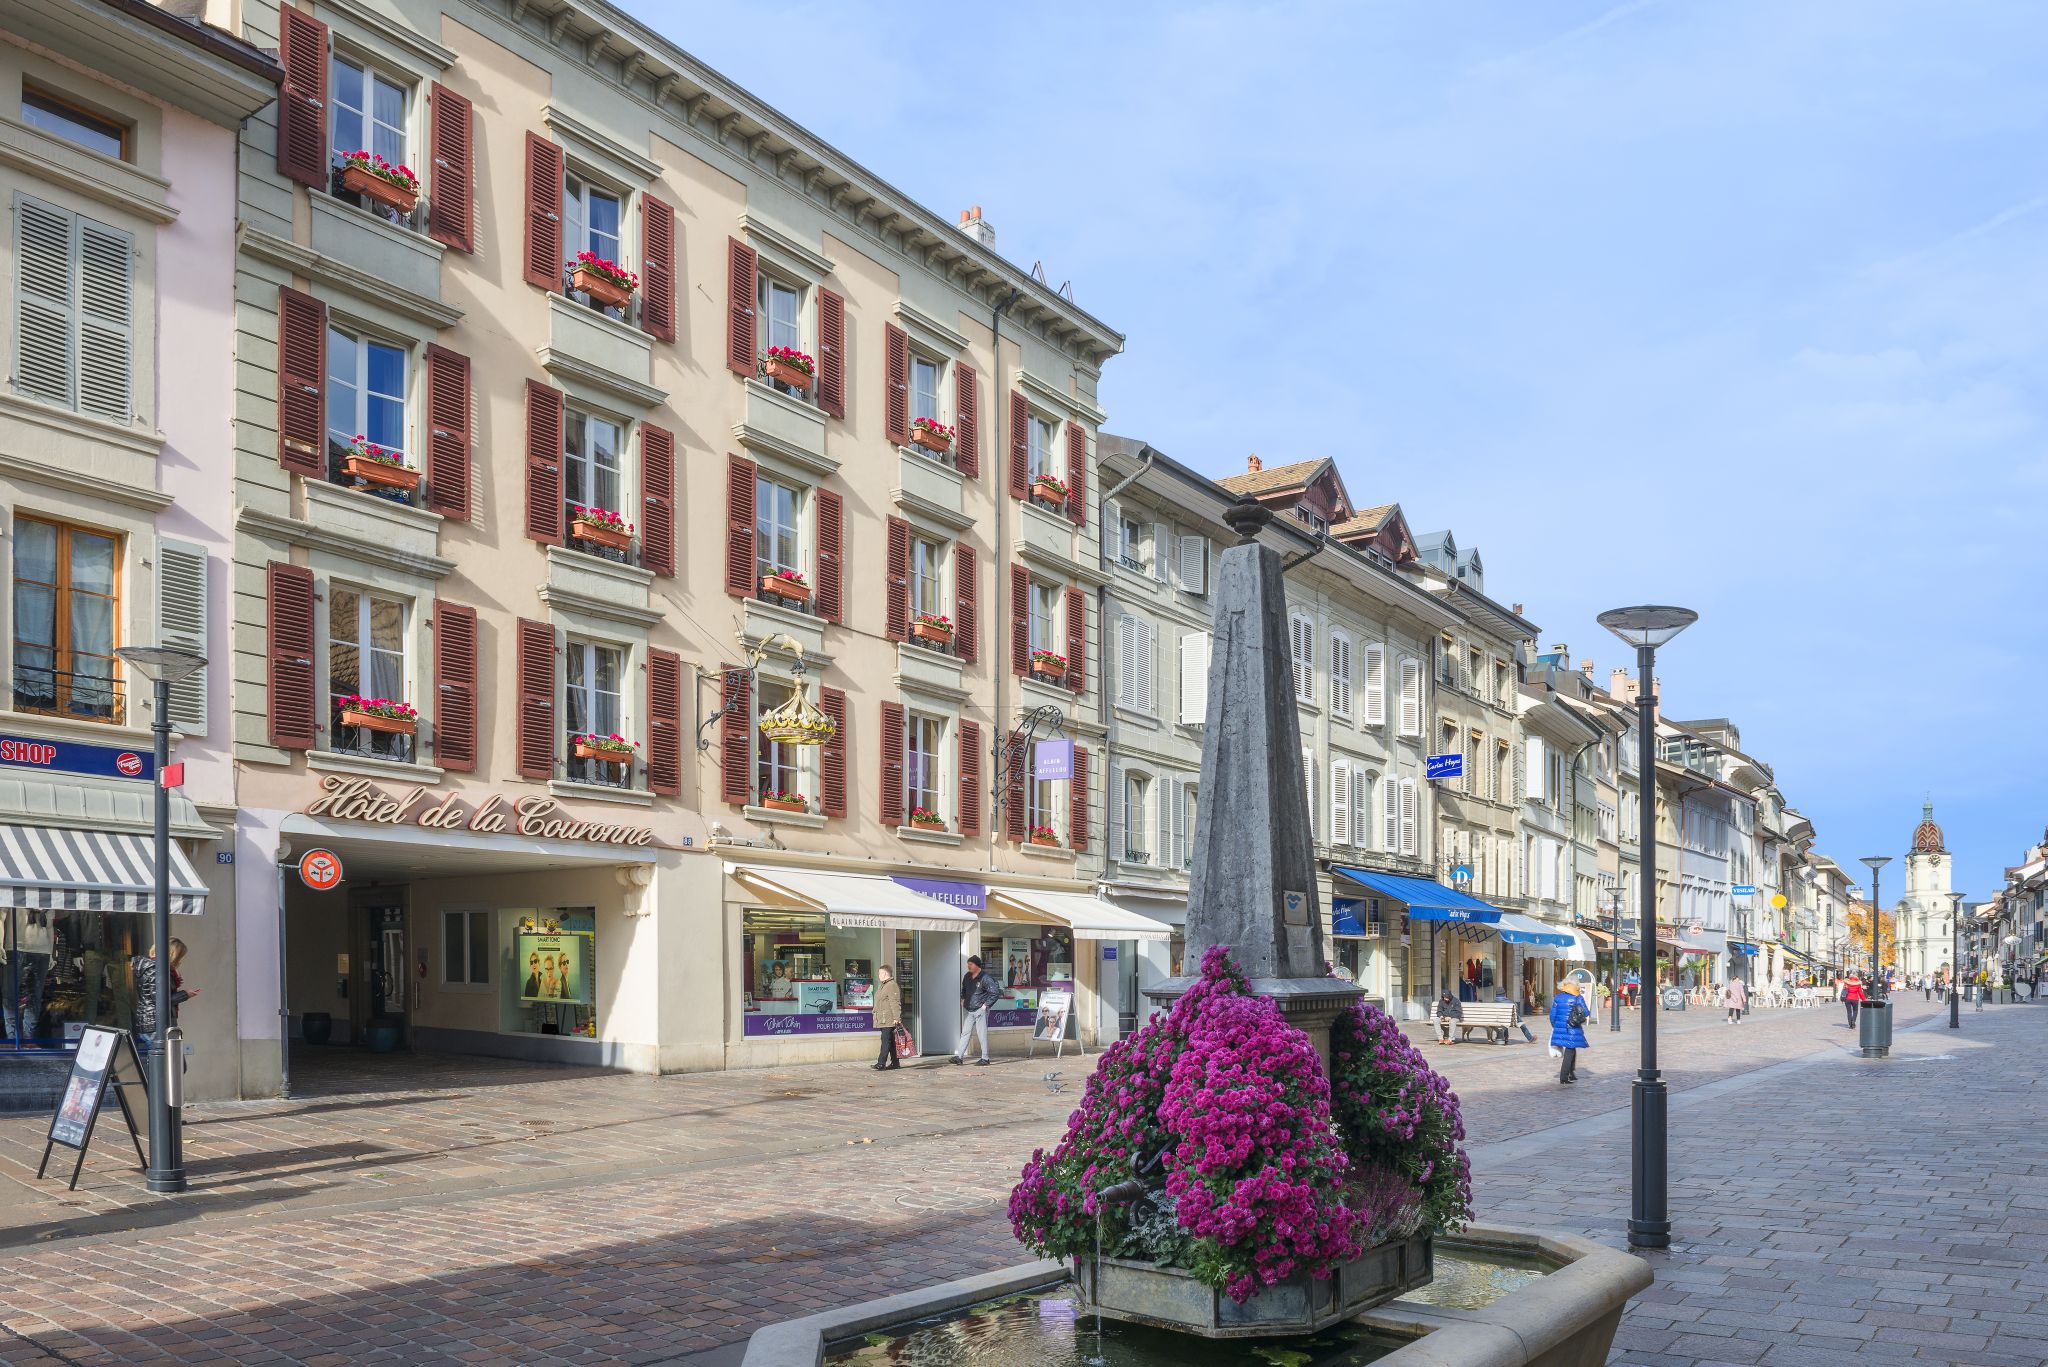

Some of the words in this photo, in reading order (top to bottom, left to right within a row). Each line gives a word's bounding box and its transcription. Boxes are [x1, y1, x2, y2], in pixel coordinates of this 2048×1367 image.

[1, 740, 56, 765] SHOP
[307, 774, 427, 824] Hôtel
[419, 791, 464, 830] de
[470, 793, 507, 833] la
[515, 795, 654, 846] Couronne
[219, 853, 232, 863] 90
[931, 891, 978, 905] AFFLELOU
[832, 917, 853, 925] ALAIN
[854, 918, 886, 927] AFFLELOU
